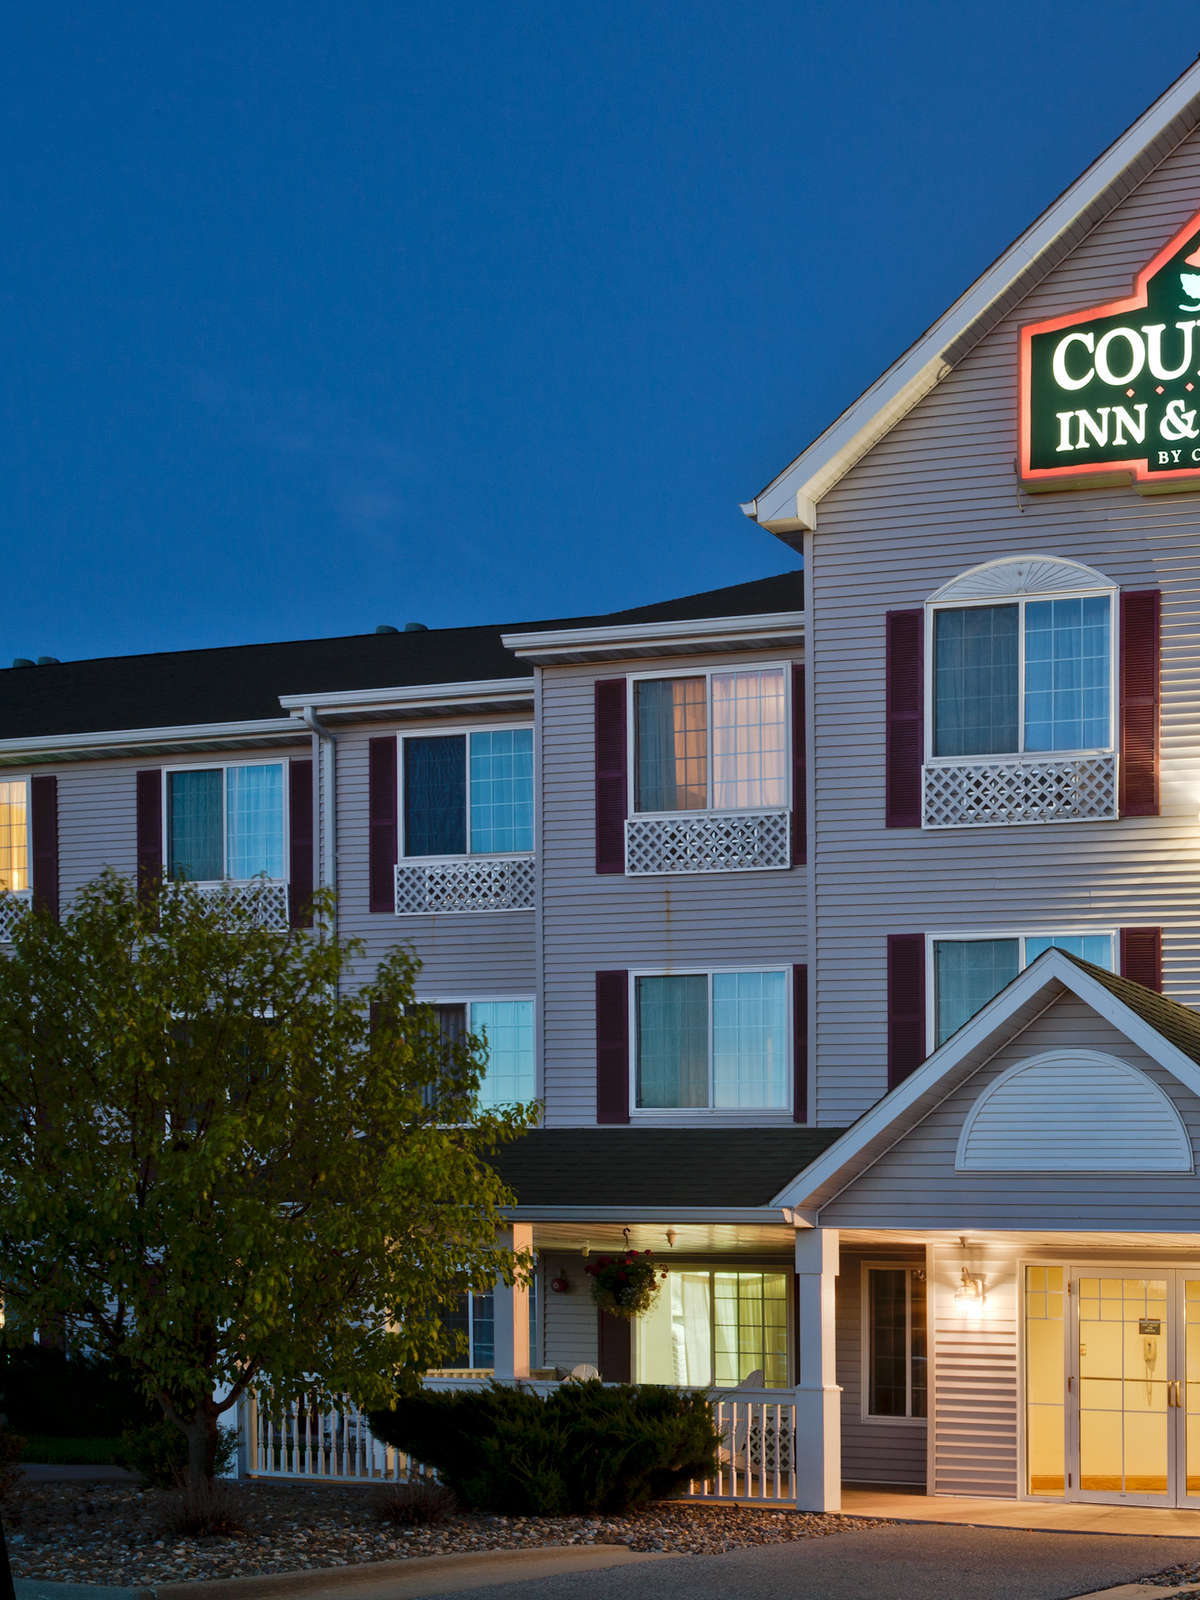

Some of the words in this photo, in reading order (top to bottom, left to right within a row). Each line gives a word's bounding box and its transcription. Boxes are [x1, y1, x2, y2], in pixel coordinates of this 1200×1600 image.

[1055, 403, 1149, 452] INN
[1159, 399, 1200, 441] &
[1158, 449, 1182, 465] BY
